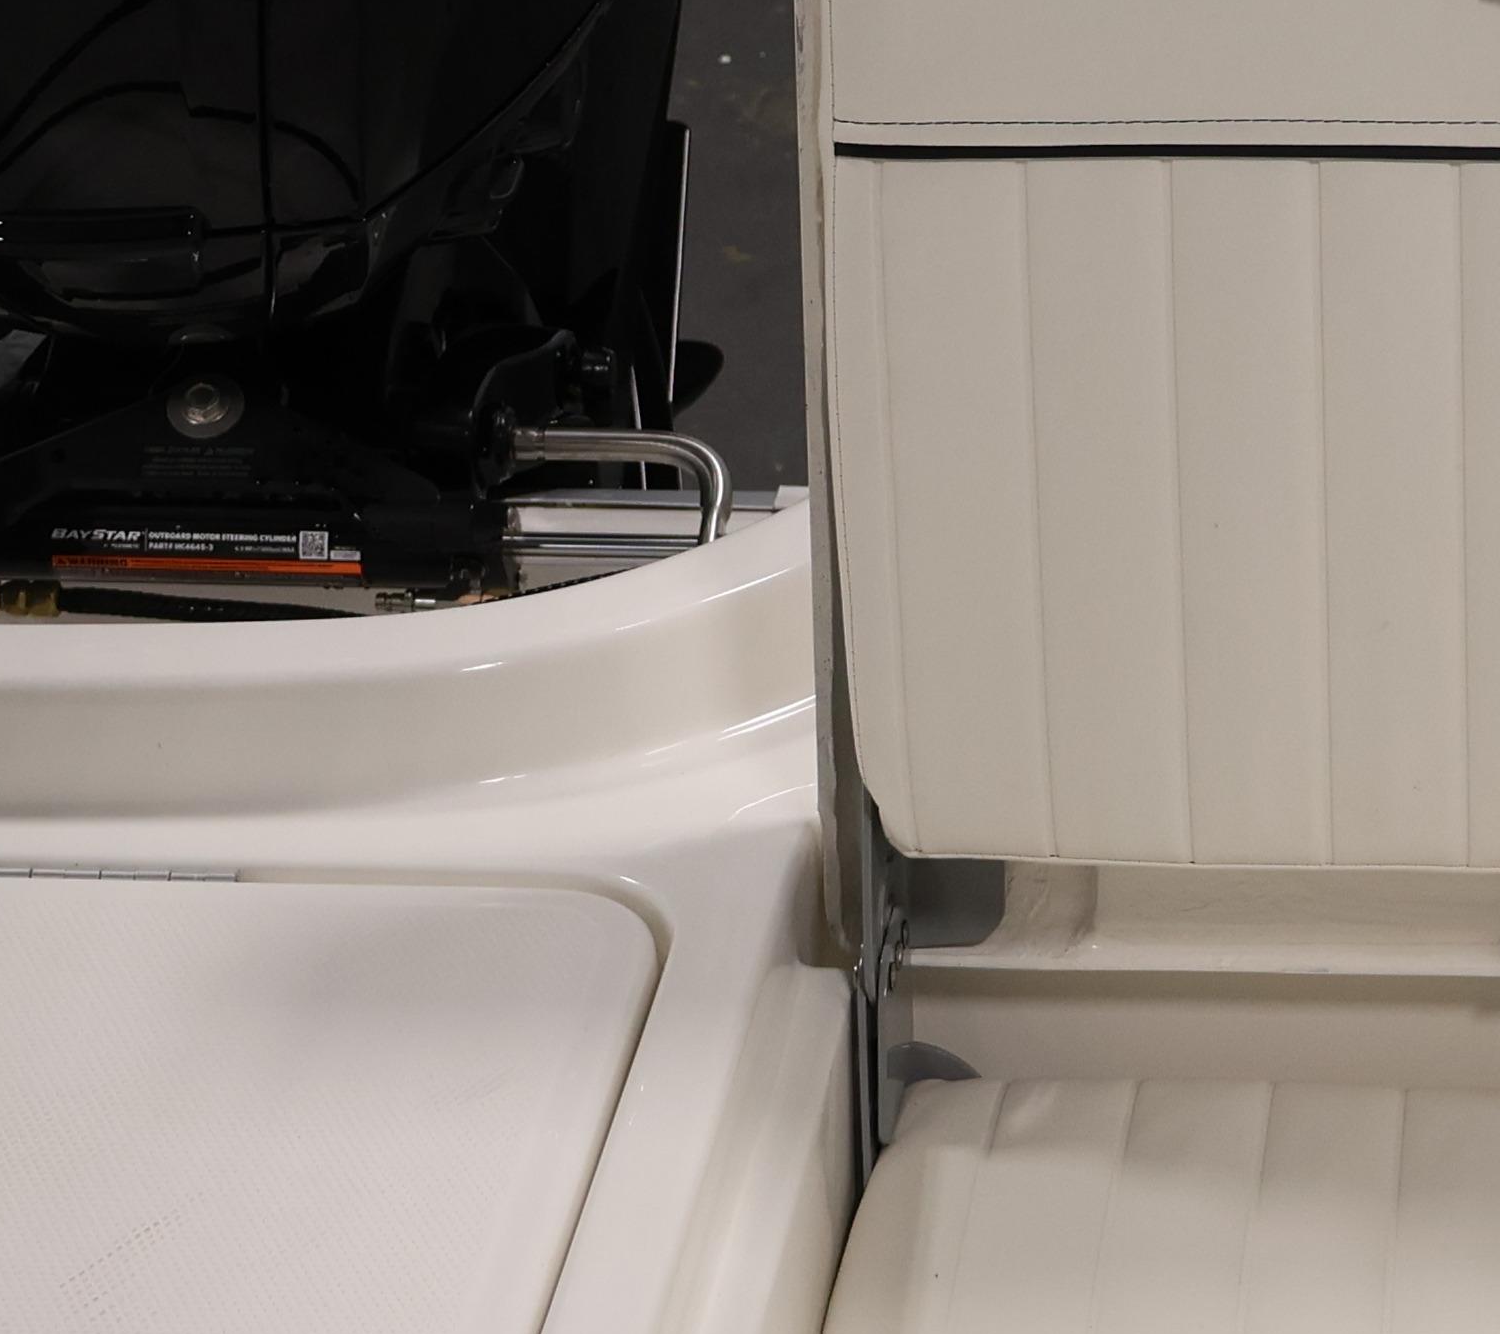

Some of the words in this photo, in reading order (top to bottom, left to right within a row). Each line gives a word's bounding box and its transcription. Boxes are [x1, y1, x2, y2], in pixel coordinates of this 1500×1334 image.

[51, 528, 141, 541] BAYSTAR
[148, 531, 191, 540] OUTBOARD
[192, 532, 221, 541] MOTOR
[221, 533, 258, 542] STEERING
[259, 534, 297, 543] CYLINDER
